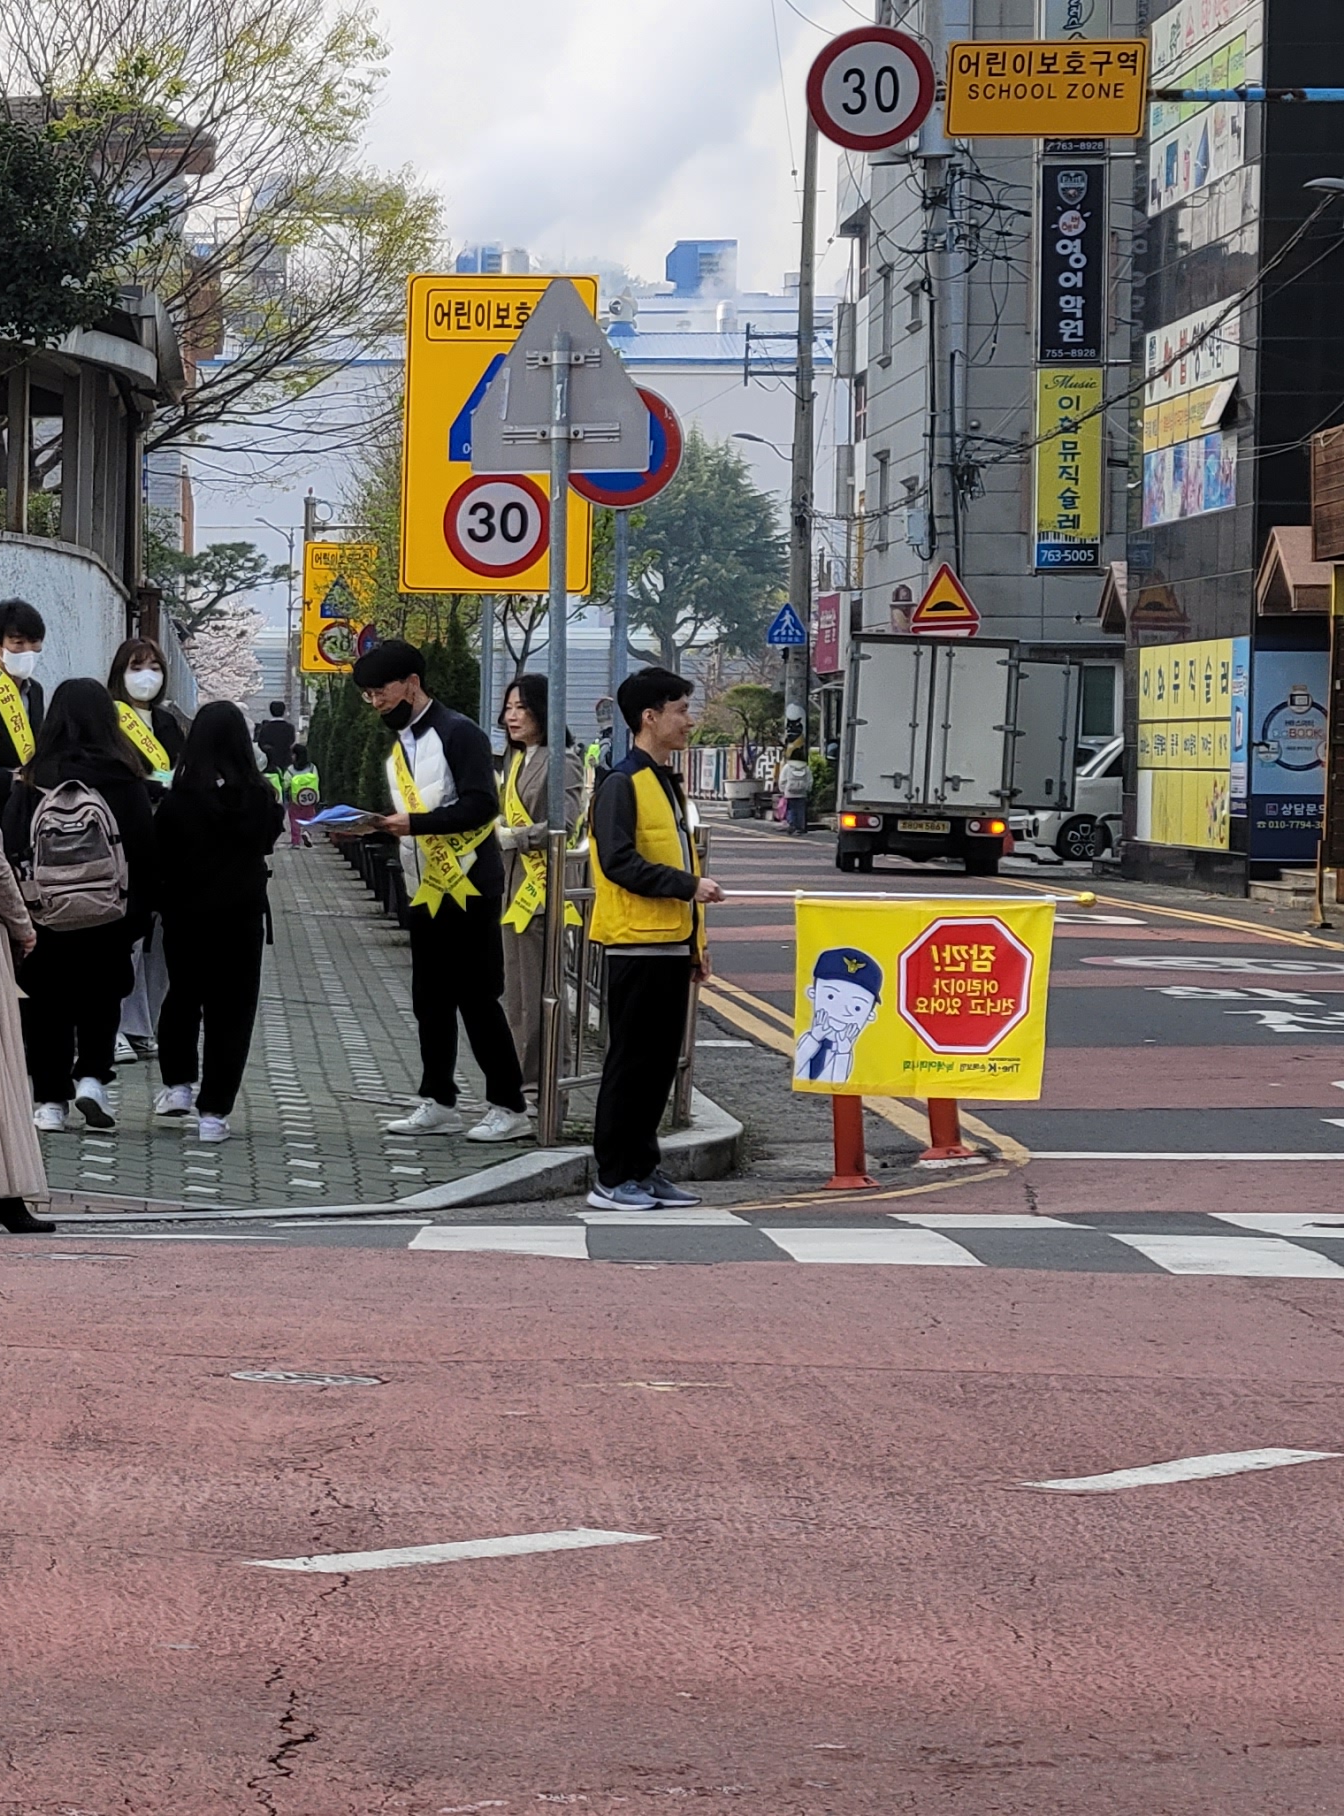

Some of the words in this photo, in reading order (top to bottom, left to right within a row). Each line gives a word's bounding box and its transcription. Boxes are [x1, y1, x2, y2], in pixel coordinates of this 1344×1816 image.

[957, 50, 1139, 77] 어린이보호구역
[841, 65, 900, 115] 30
[968, 83, 1057, 101] SCHOOL
[1067, 82, 1125, 99] ZONE
[1055, 141, 1104, 151] 763-8928
[1055, 238, 1087, 343] 영어학원
[1045, 348, 1096, 358] 755-8928
[1044, 374, 1097, 390] Music
[467, 501, 529, 544] 30
[1040, 549, 1095, 563] 763-5005
